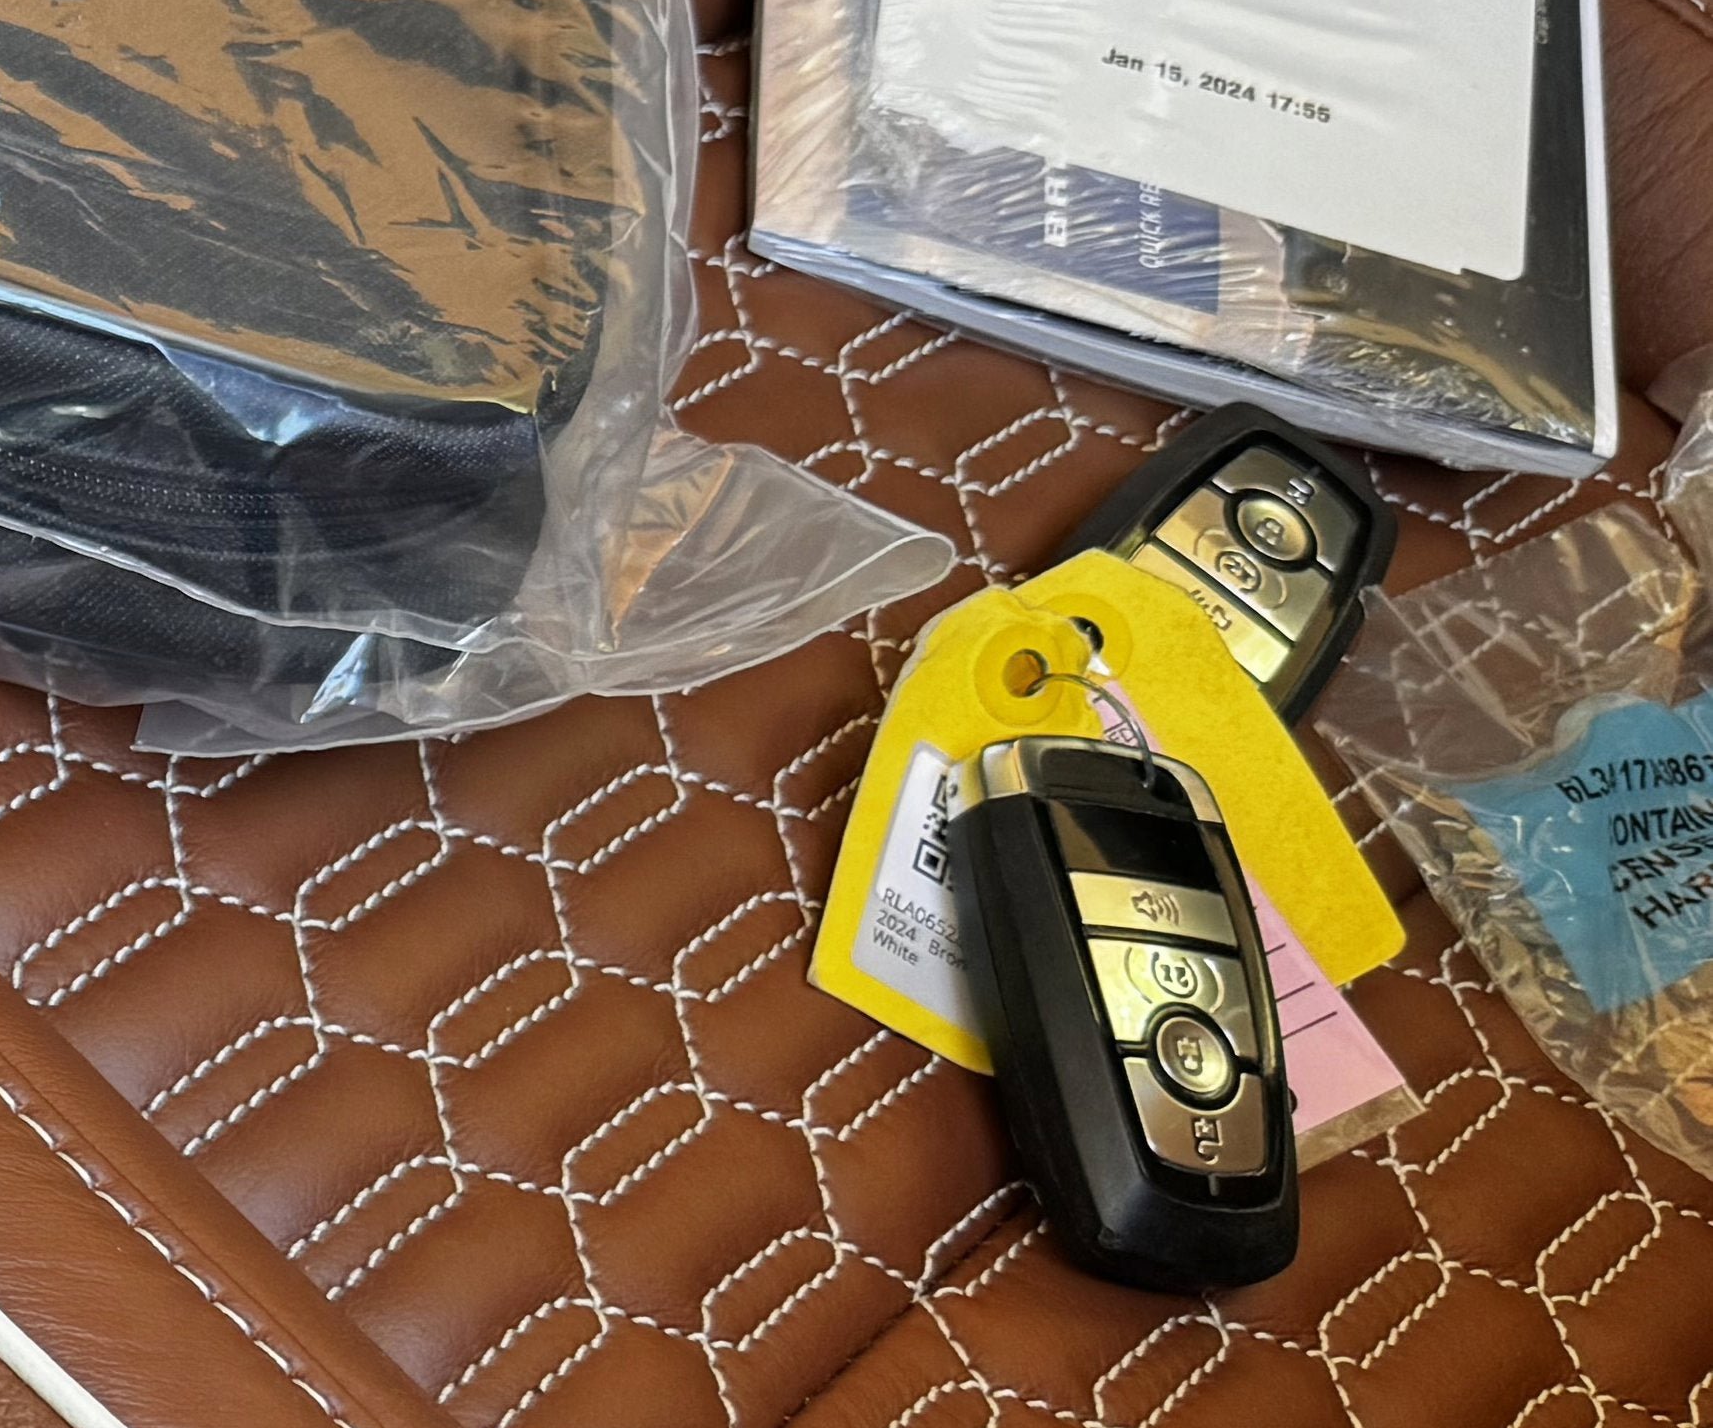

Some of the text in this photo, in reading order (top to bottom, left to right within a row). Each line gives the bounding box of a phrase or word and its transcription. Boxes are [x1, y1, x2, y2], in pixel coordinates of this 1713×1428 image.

[1101, 47, 1332, 123] Jan 15, 2024 17:55
[1138, 209, 1164, 269] QUICK
[873, 927, 919, 966] White
[876, 908, 917, 942] 2024
